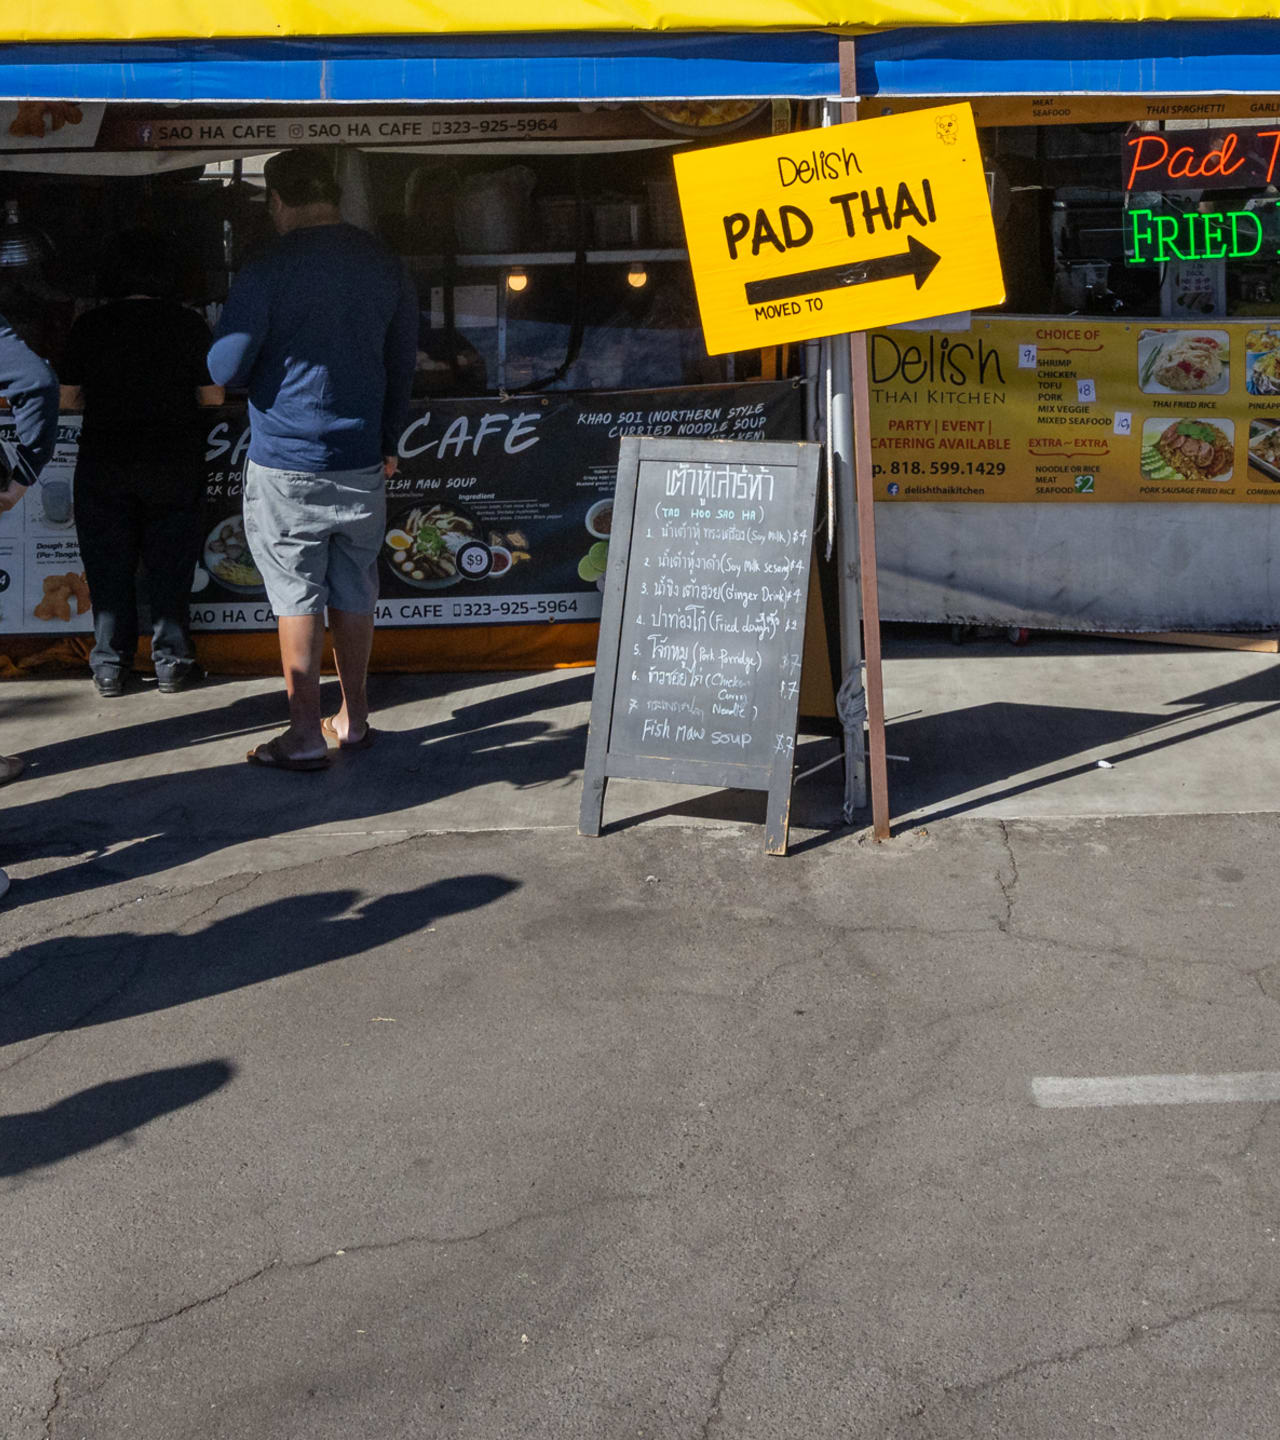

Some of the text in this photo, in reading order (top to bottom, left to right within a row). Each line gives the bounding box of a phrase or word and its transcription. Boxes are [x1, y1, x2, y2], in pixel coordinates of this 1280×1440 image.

[1032, 98, 1054, 106] MEAT
[1032, 108, 1071, 117] SEAFOOD
[1147, 103, 1226, 114] THAI SPAGHETTI
[158, 118, 559, 140] SAO HA CAFE SAO HA CAFE 323-925-5964
[777, 148, 862, 187] Delish
[1127, 133, 1246, 190] Pad
[723, 179, 937, 260] PAD THAI
[1128, 209, 1264, 263] FRIED
[755, 297, 823, 321] MOVED TO
[1037, 329, 1100, 340] CHOICE OF
[871, 334, 1006, 385] Delish
[1038, 359, 1072, 367] SHRIMP
[1037, 371, 1077, 379] CHICKEN
[1038, 382, 1062, 390] TOFU
[872, 389, 1006, 404] THAI KITCHEN
[1038, 393, 1063, 401] PORK
[1038, 405, 1090, 414] MIX VEGGIE
[1174, 401, 1197, 409] FRIED
[1199, 401, 1216, 409] RICE
[577, 402, 768, 426] KHAO SOI (NORTHERN STYLE
[889, 420, 985, 432] PARTY EVENT
[1037, 416, 1112, 426] MIXED SEAFOOD
[608, 417, 767, 439] CURRIED NOODLE SOUP
[397, 410, 543, 460] CAFE
[871, 438, 1011, 450] CATERING AVAILABLE
[1029, 439, 1108, 448] EXTRA EXTRA
[872, 462, 1006, 478] p. 818. 599.1429
[1036, 466, 1070, 474] NOODLE
[415, 479, 441, 489] MAW
[446, 477, 477, 488] SOUP
[1036, 476, 1057, 484] MEAT
[1075, 476, 1094, 493] $2
[904, 486, 984, 496] delishthaikitchen
[1036, 486, 1073, 495] SEAFOOD
[1162, 487, 1196, 495] SAUSAGE
[458, 493, 496, 501] Ingredient
[690, 507, 711, 519] HOO
[742, 506, 765, 523] HA)
[36, 543, 63, 552] Dough
[466, 554, 483, 566] $9
[640, 582, 649, 595] 3.
[720, 582, 758, 608] (Ginger
[761, 586, 787, 608] Drink)
[222, 610, 246, 622] HA
[254, 609, 276, 622] CA
[400, 604, 443, 618] CAFE
[464, 599, 578, 616] 323-925-5964
[708, 610, 740, 634] (Fried
[633, 643, 642, 656] 5.
[642, 718, 671, 742] Fish
[675, 724, 705, 742] Maw
[711, 732, 752, 748] soup
